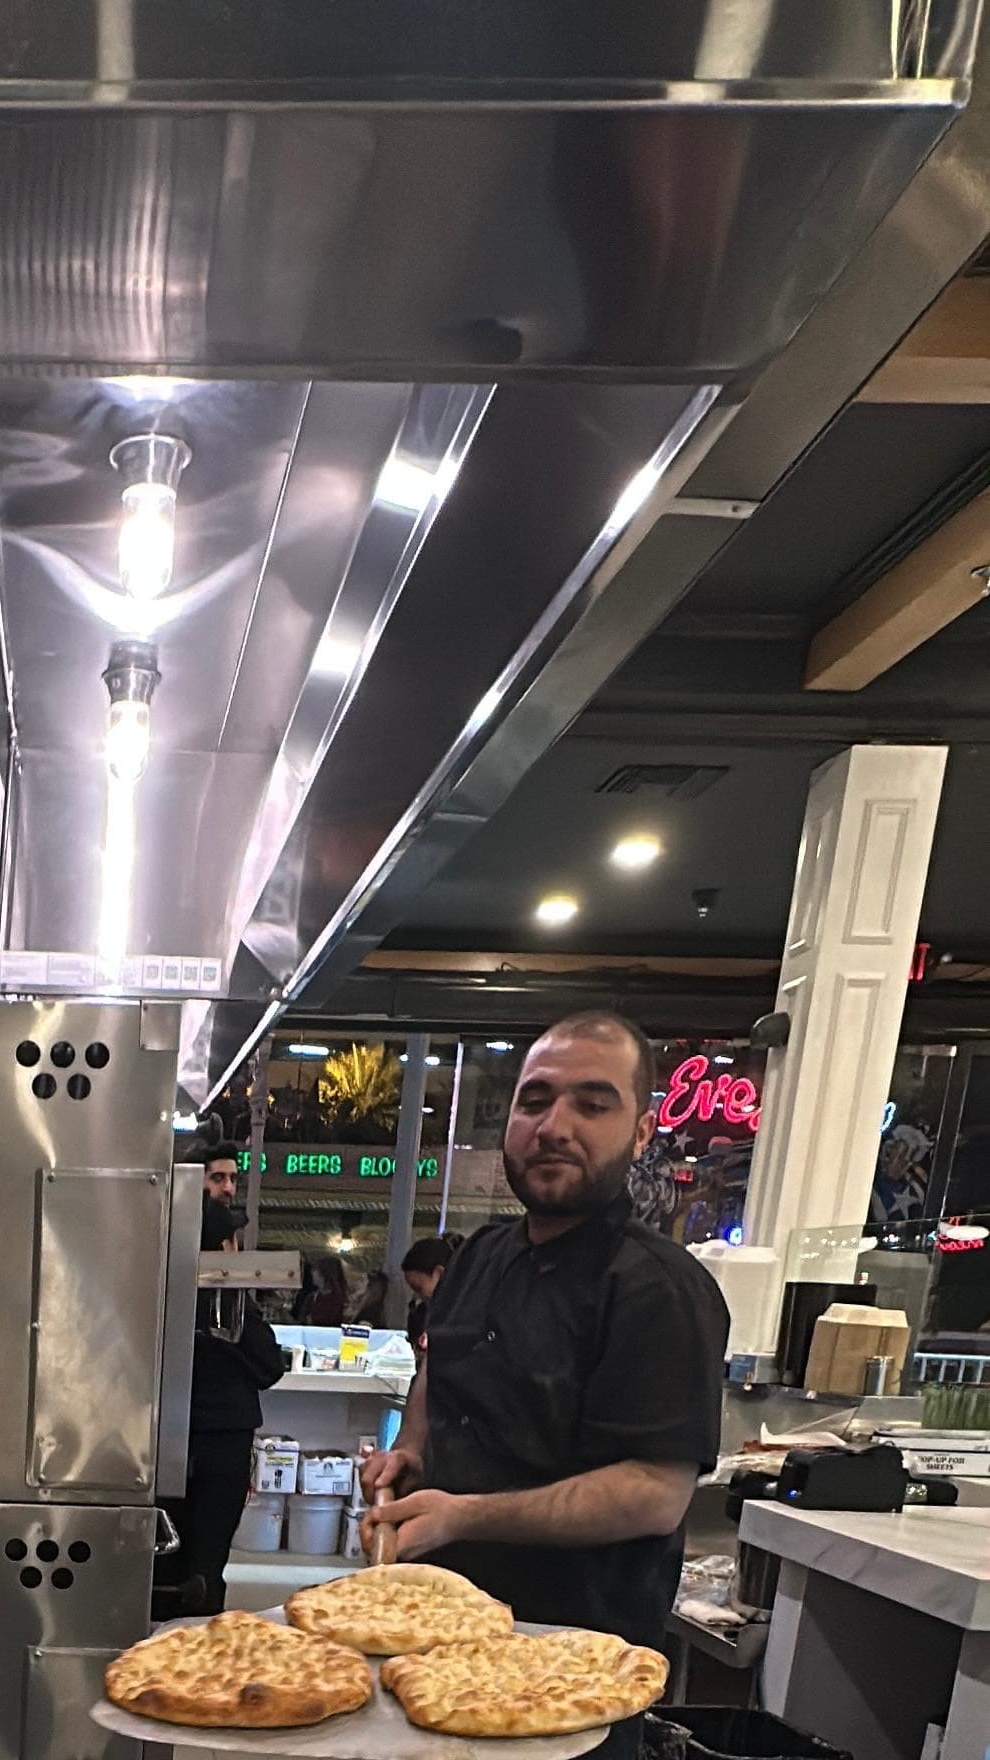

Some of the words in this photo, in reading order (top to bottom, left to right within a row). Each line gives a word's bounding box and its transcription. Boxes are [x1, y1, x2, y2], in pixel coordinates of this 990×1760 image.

[658, 1054, 762, 1132] Eve
[286, 1153, 342, 1175] BEERS
[360, 1156, 439, 1178] BLOYS
